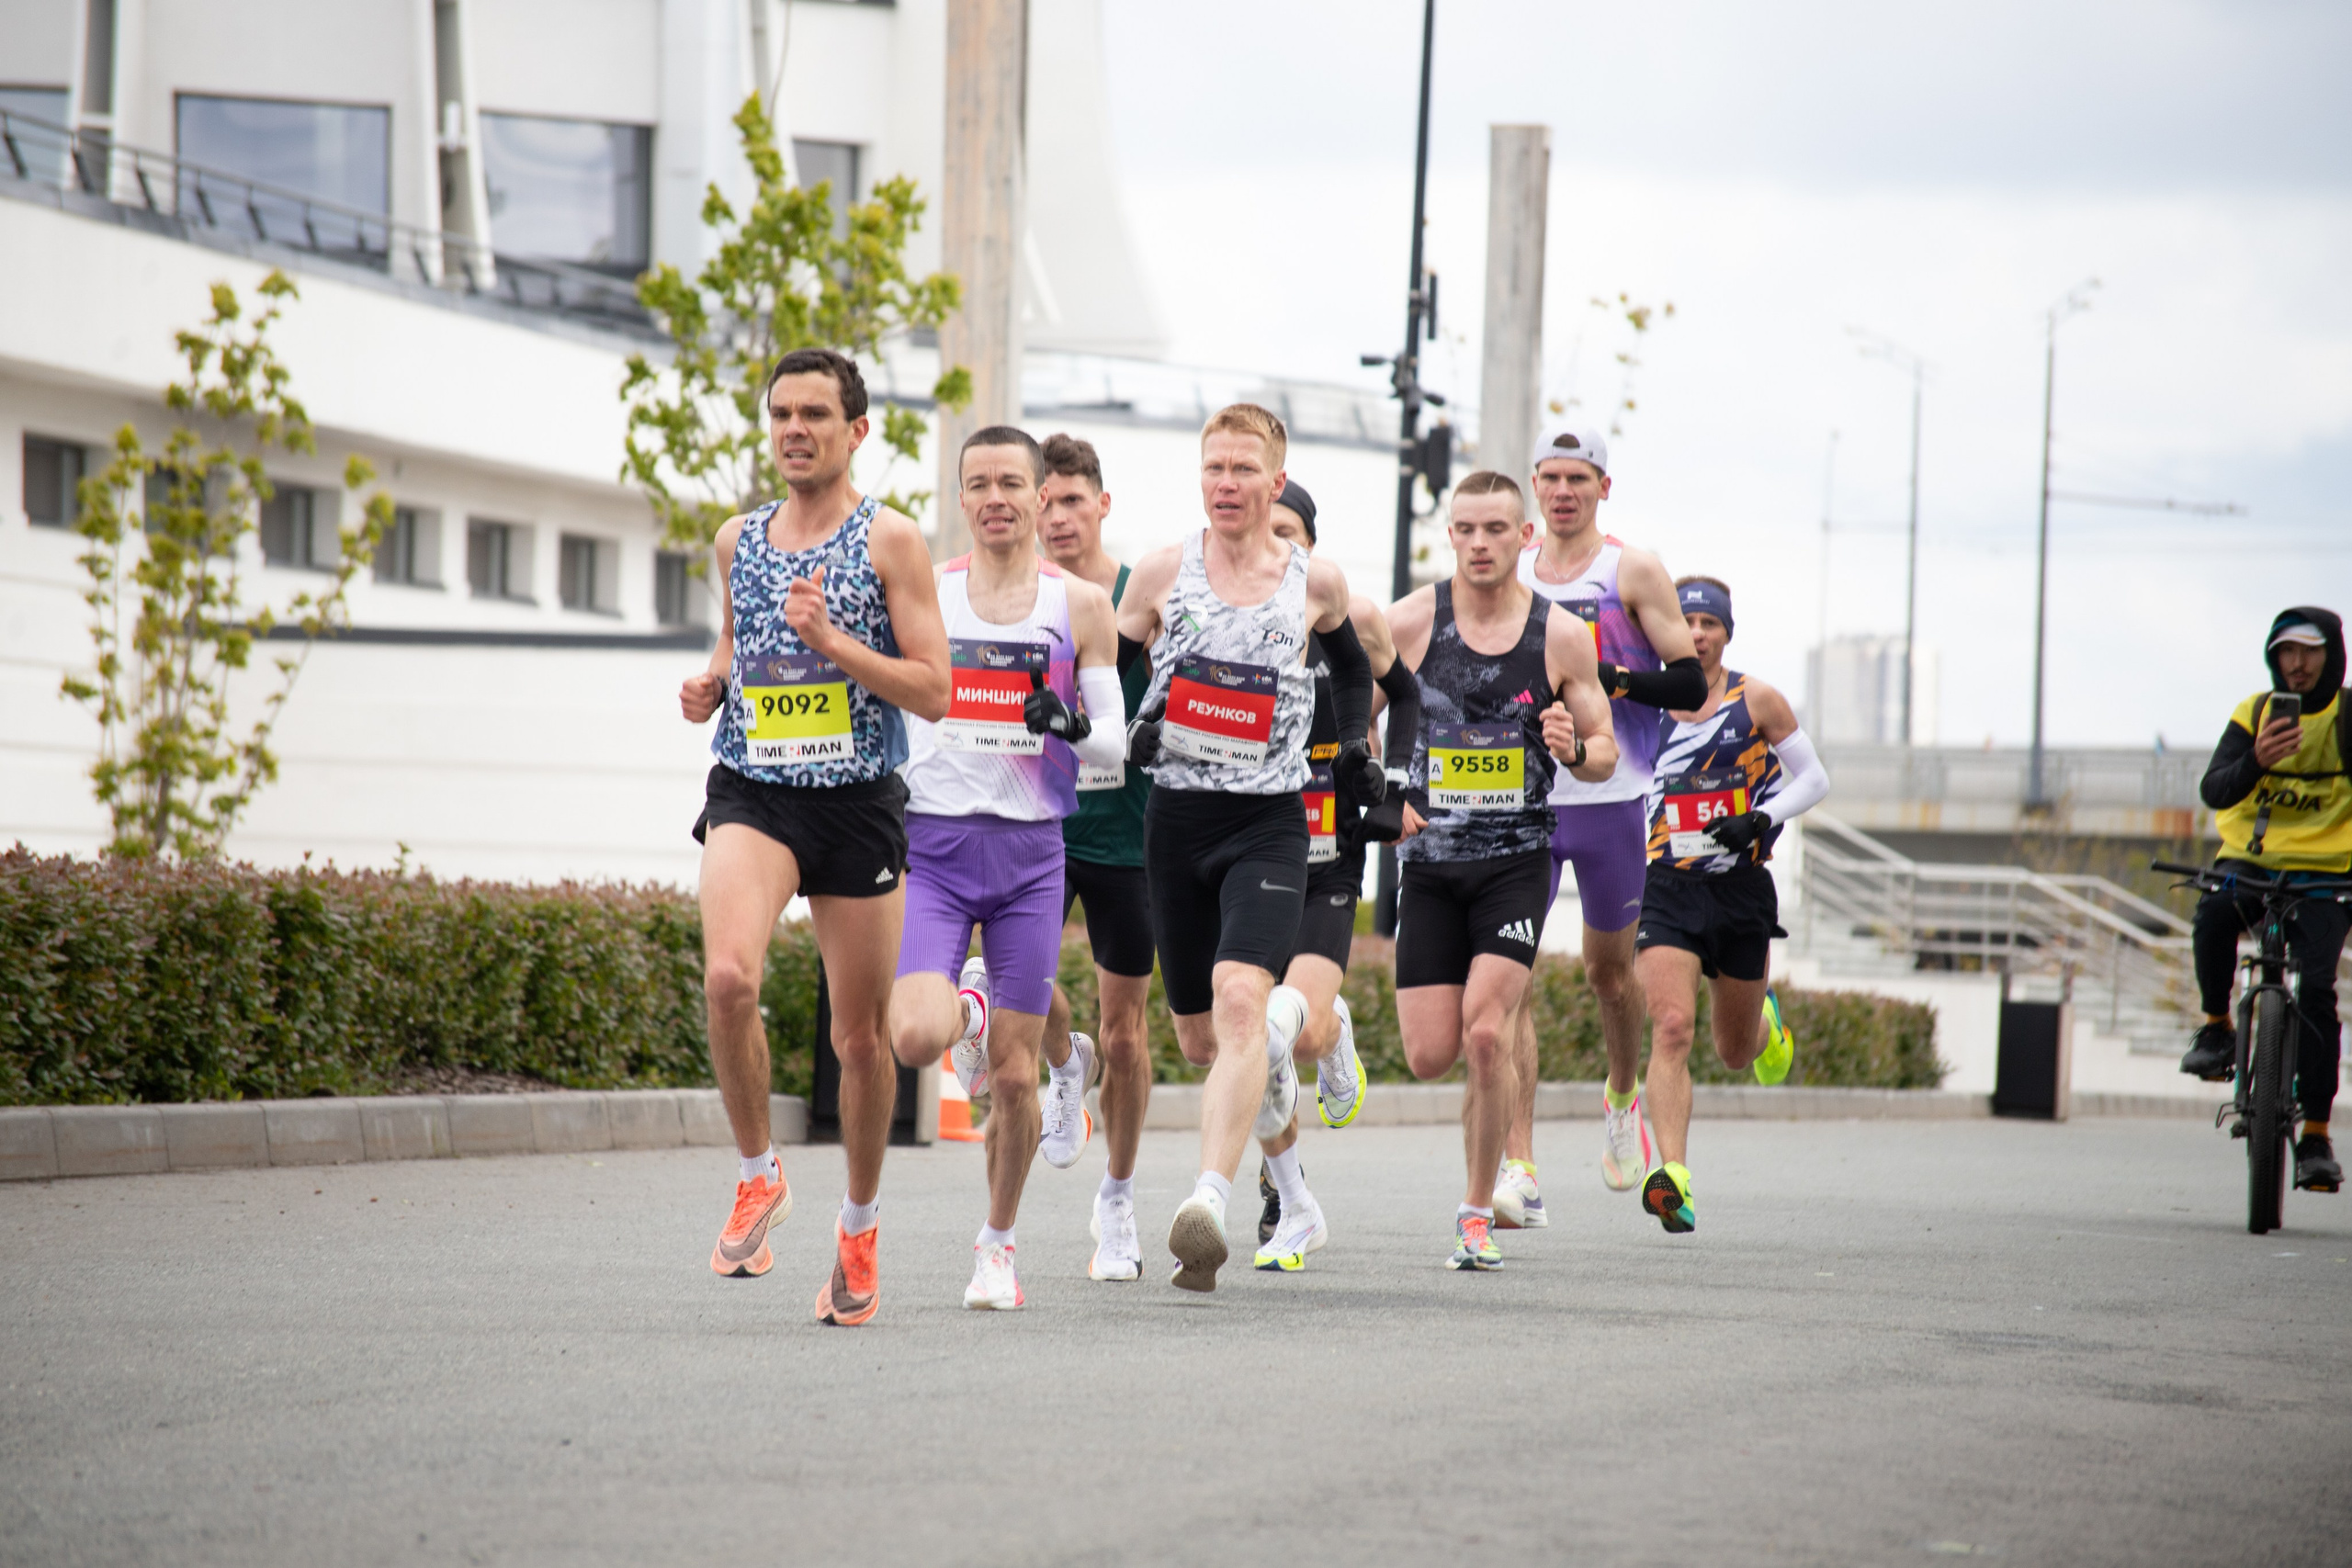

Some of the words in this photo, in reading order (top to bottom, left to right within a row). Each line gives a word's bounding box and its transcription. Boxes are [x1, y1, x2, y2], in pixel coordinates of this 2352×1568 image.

[761, 692, 831, 717] 9092
[1187, 698, 1257, 725] РЕУНКОВ
[1431, 763, 1441, 774] A
[1451, 755, 1510, 773] 9558
[1697, 798, 1729, 824] 56
